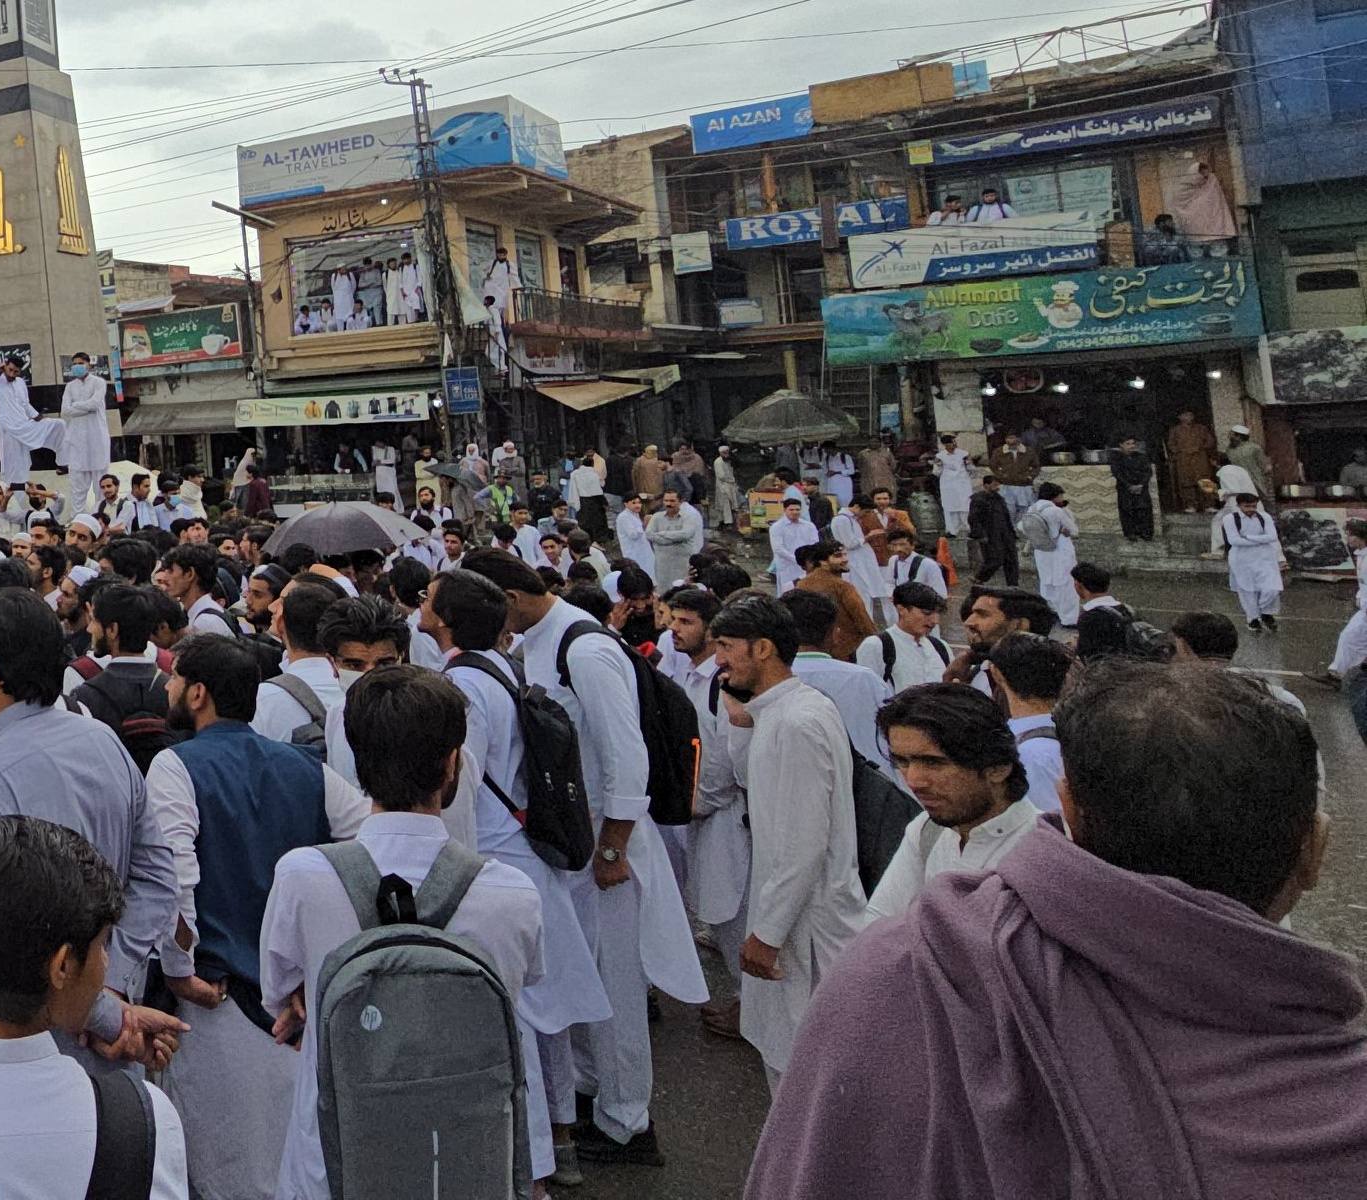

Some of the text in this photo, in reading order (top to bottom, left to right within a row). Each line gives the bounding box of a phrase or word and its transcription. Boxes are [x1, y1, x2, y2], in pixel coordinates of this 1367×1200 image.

[729, 107, 781, 130] AZAN
[1180, 105, 1212, 124] فخر
[262, 134, 375, 167] AL-TAWHEED
[285, 153, 348, 175] TRAVELS
[931, 234, 1006, 256] Al-Fazal
[1037, 246, 1097, 268] الفضل
[967, 307, 1019, 329] Cafe
[364, 1011, 377, 1029] hp
